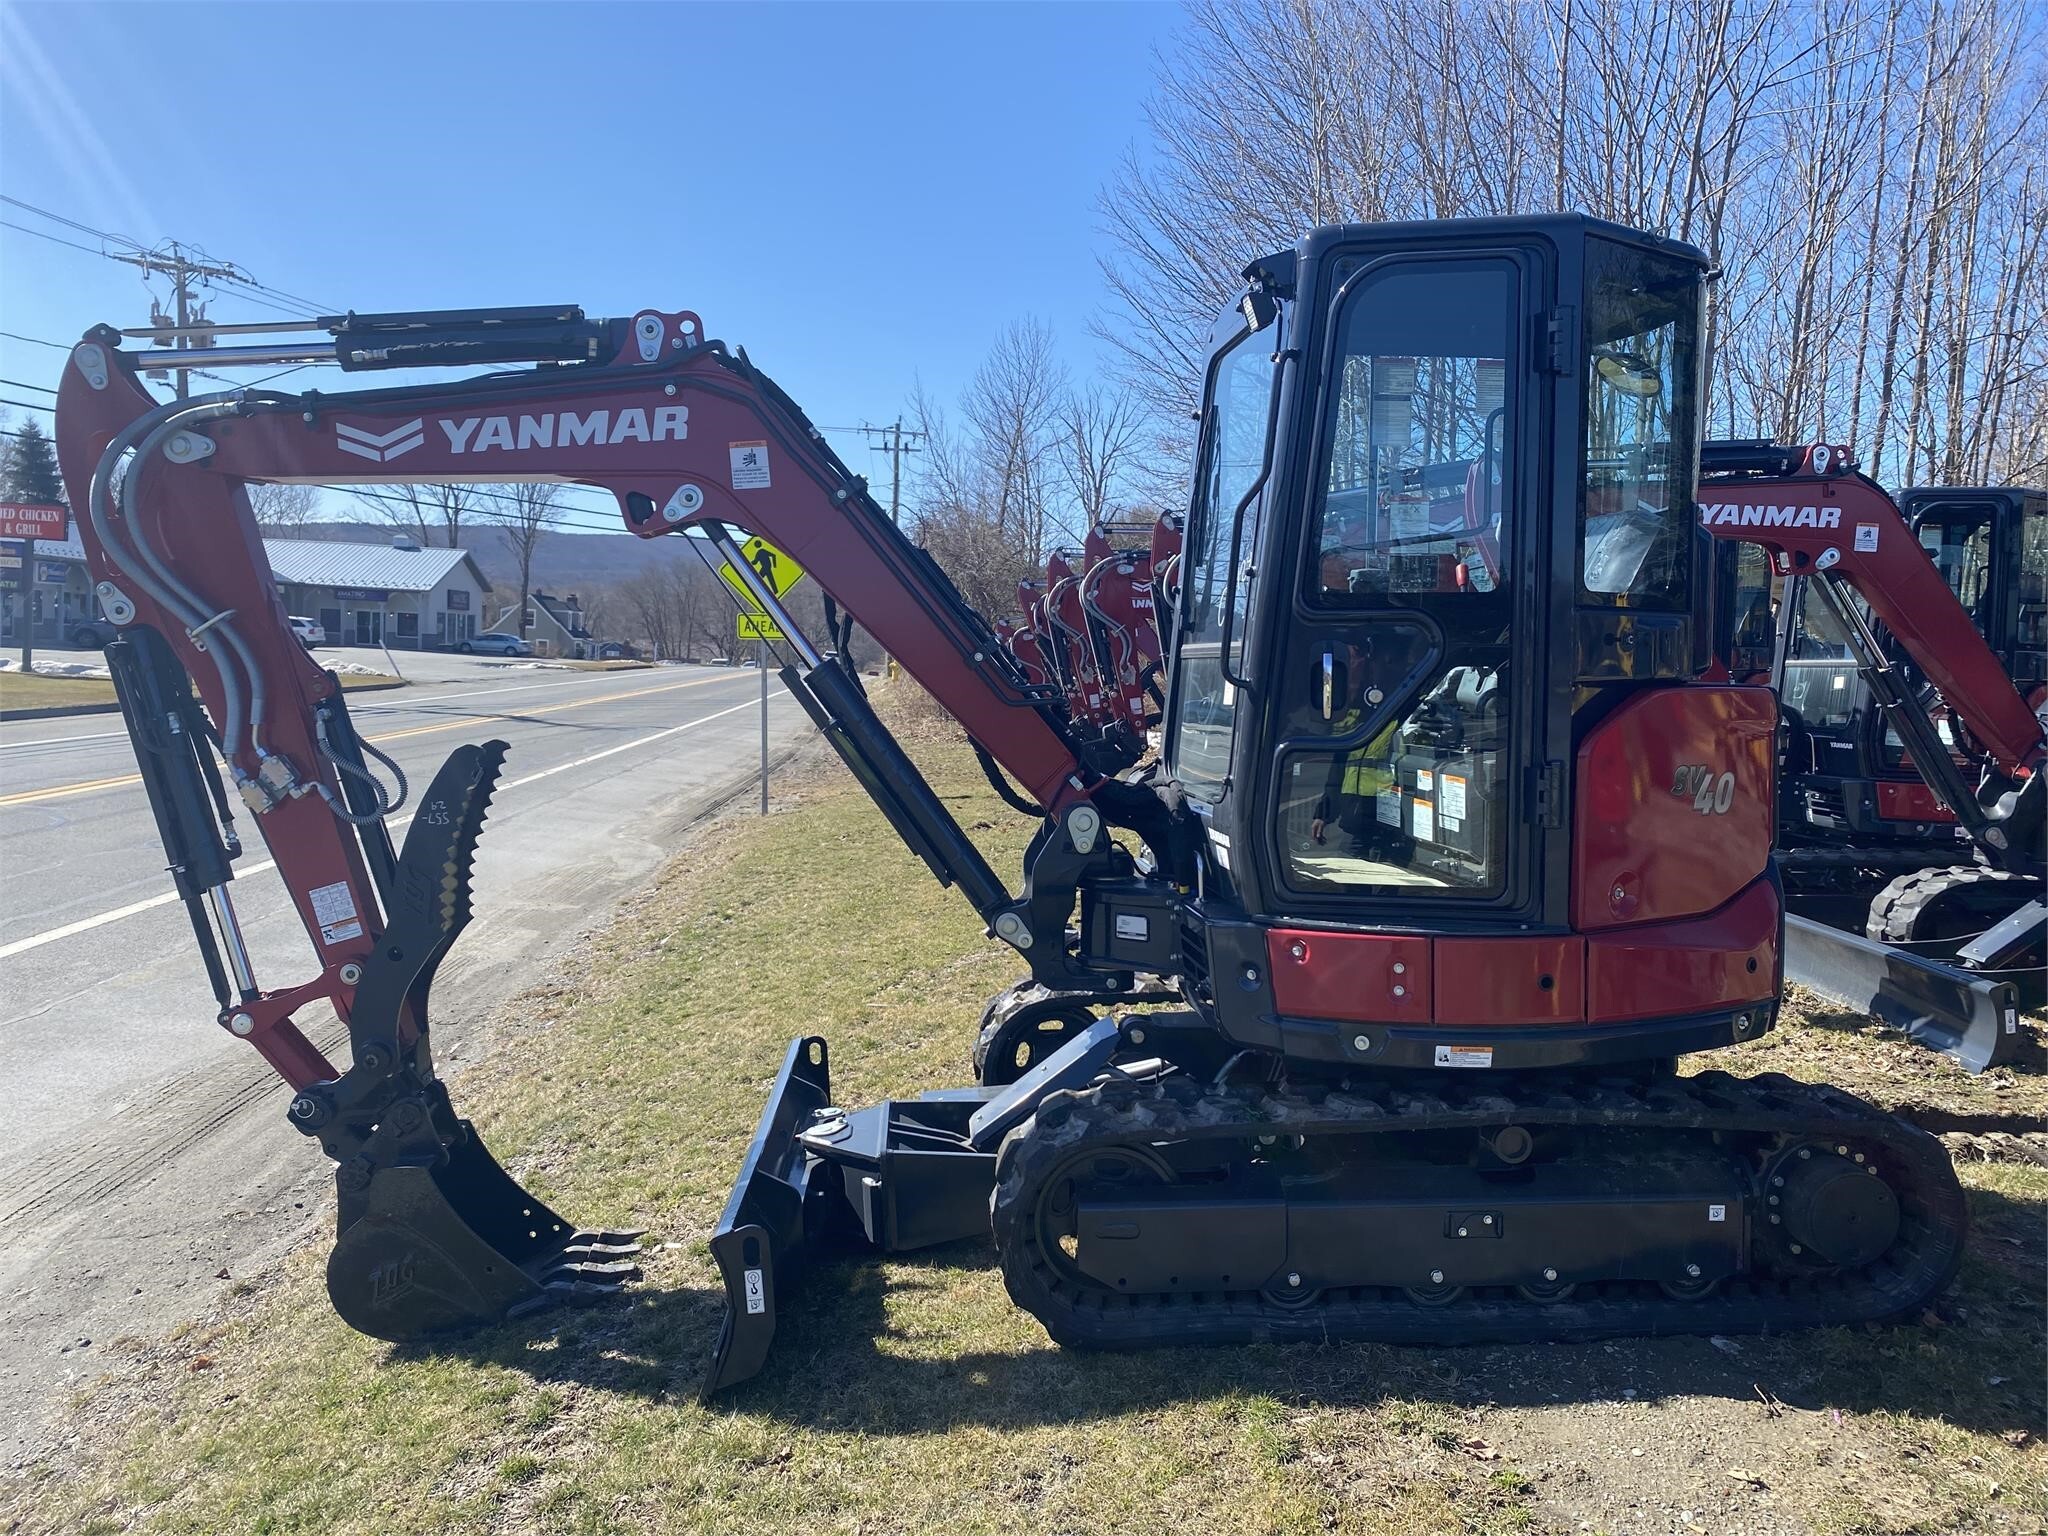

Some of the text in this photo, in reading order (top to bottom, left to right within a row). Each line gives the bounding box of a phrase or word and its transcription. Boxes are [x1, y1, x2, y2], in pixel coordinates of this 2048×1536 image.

[439, 405, 689, 454] YANMAR
[20, 508, 60, 522] CHICKEN
[1698, 503, 1842, 529] YANMAR
[5, 522, 43, 536] & GRILL
[744, 620, 780, 633] AHEA
